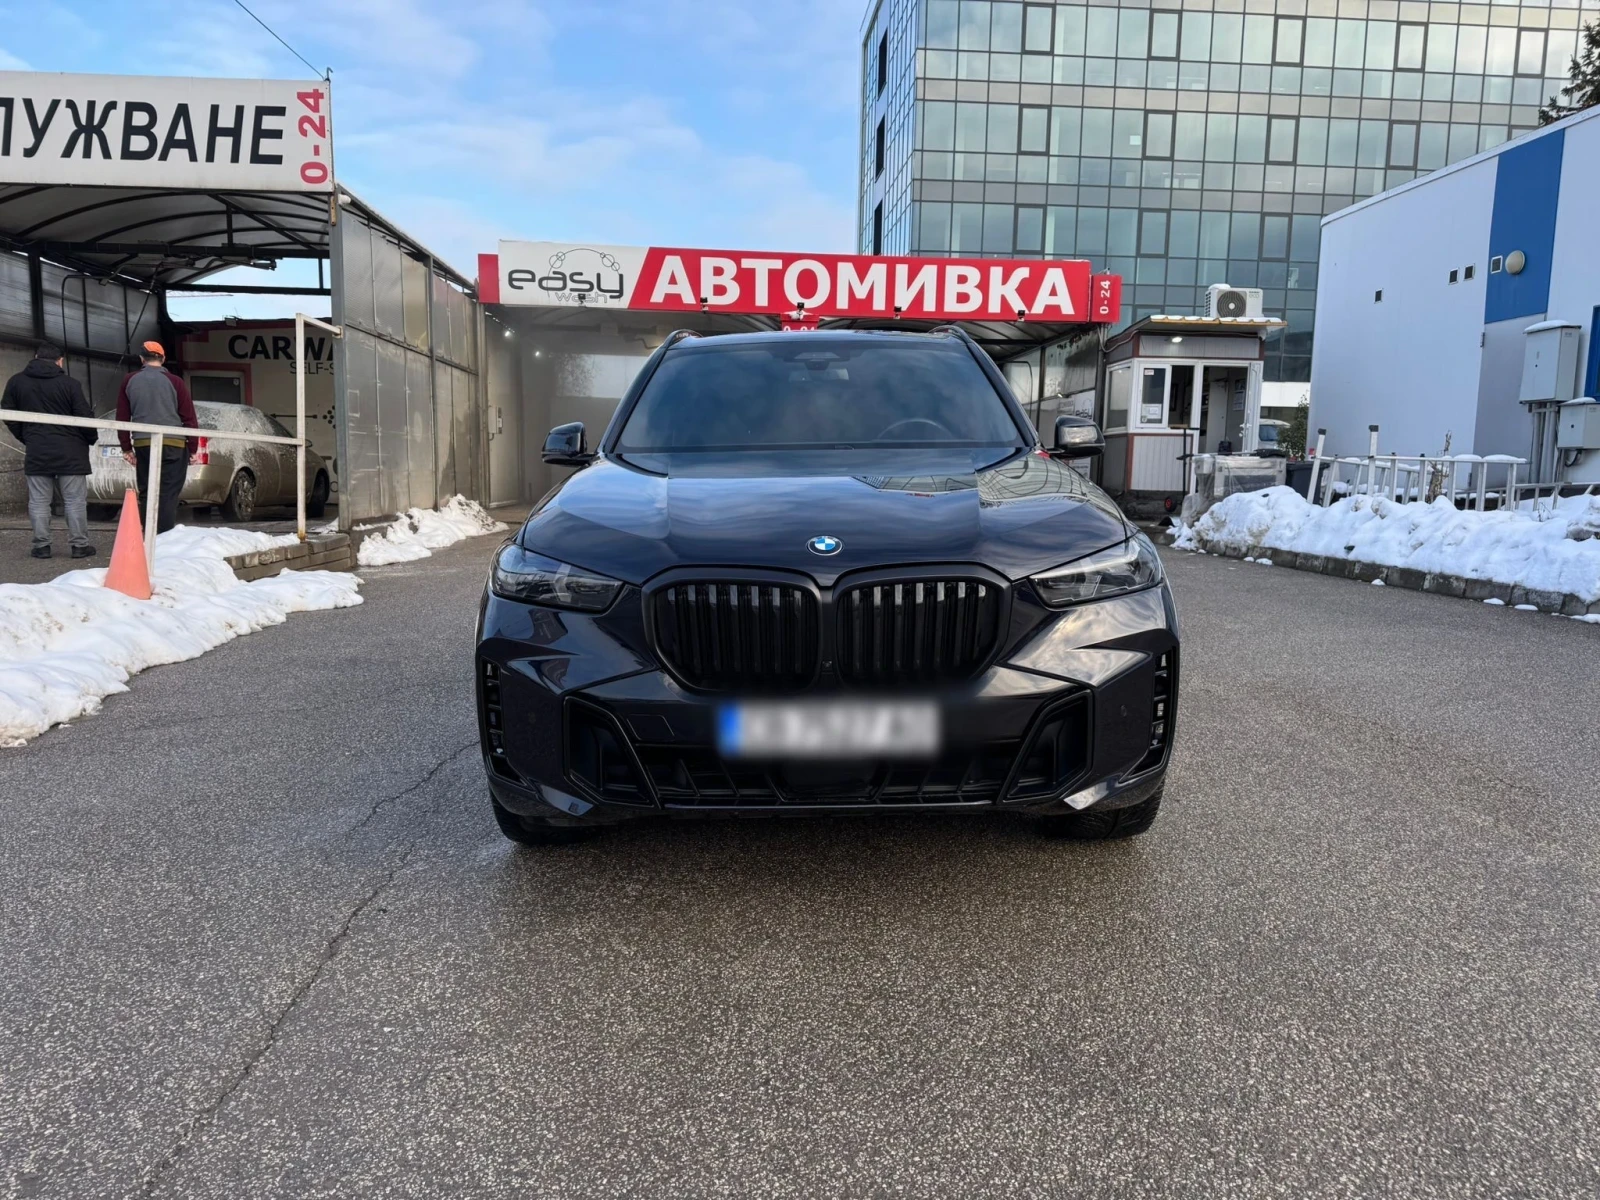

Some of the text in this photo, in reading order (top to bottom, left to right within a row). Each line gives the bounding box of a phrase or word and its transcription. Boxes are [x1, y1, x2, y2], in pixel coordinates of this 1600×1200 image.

[297, 89, 328, 184] 0-24
[508, 268, 623, 299] easy
[649, 255, 1075, 316] АВТОМИВКА
[1100, 280, 1111, 315] 0-24
[228, 334, 333, 361] CARW
